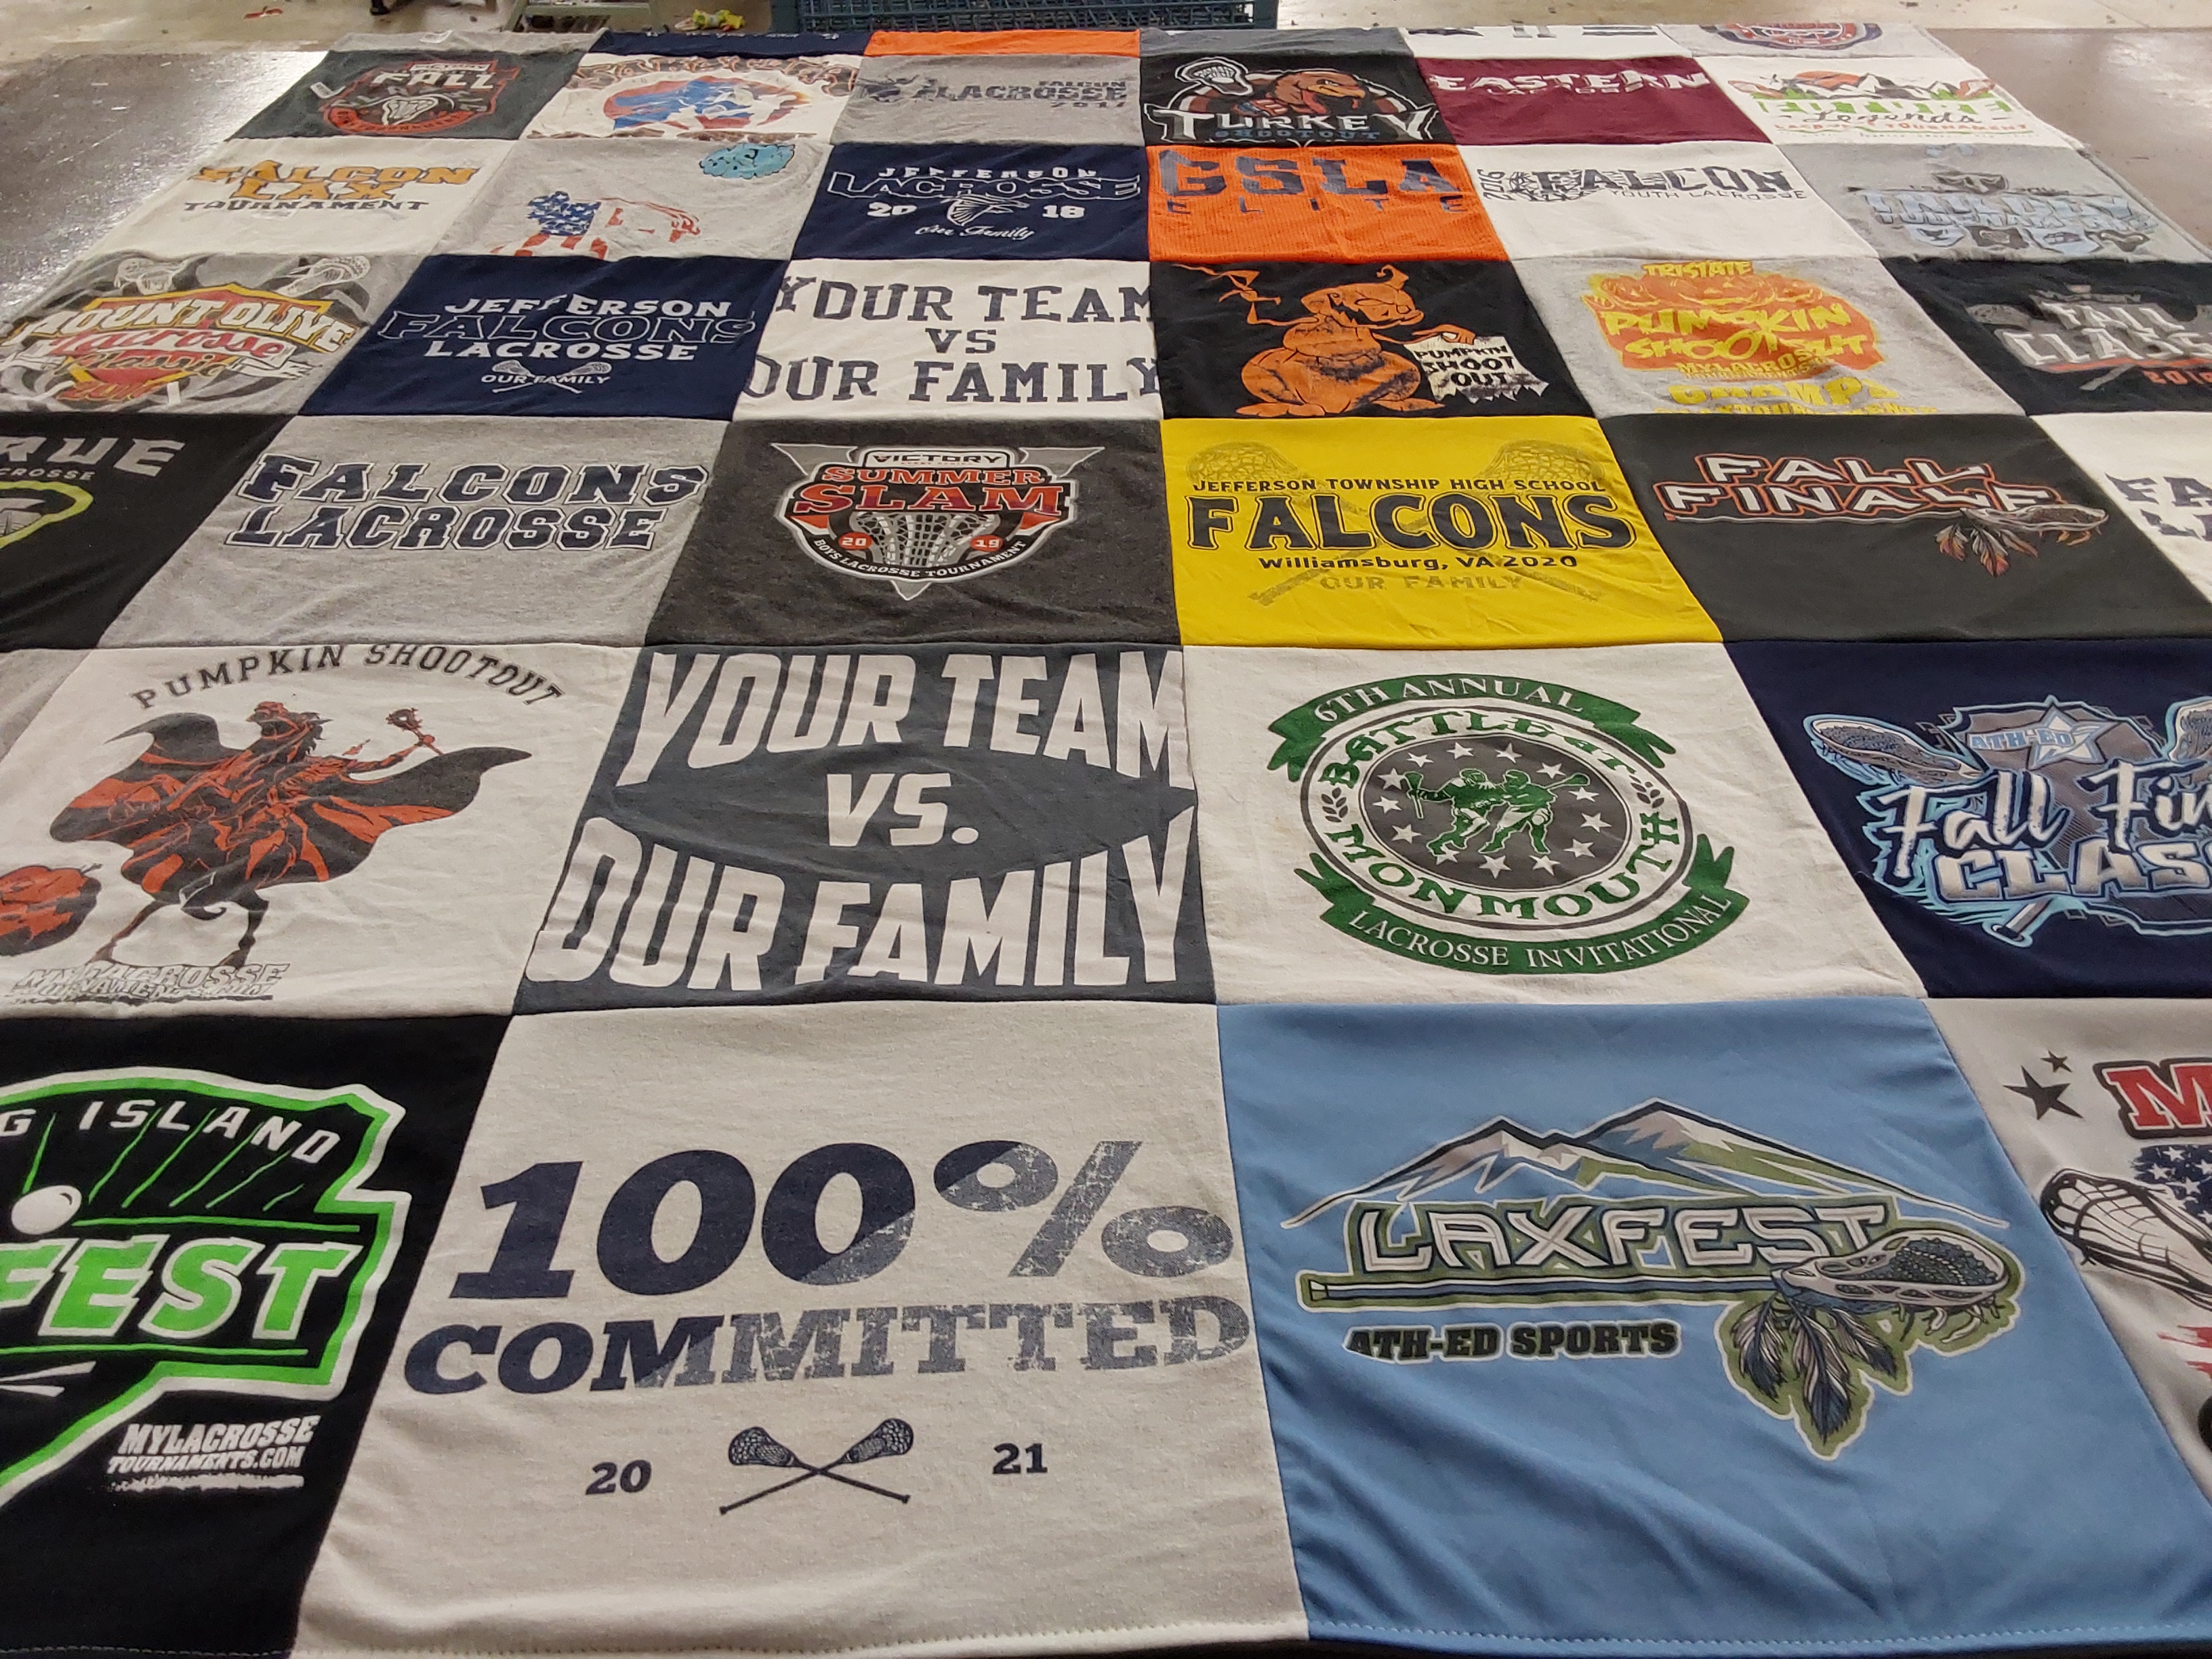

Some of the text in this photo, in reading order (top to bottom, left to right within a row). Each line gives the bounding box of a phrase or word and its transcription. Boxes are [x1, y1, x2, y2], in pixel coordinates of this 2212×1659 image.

[373, 71, 495, 89] FALL
[1430, 69, 1711, 93] EASTERN
[1147, 107, 1437, 142] TURKEY
[188, 160, 480, 185] FALCON
[229, 178, 407, 201] LAX
[1158, 149, 1462, 197] GSLA
[1530, 166, 1795, 194] FALCON
[184, 200, 430, 211] TOURNAMENT
[867, 202, 1086, 219] 20 18
[1166, 194, 1467, 215] ELITE
[1611, 190, 1680, 199] YOUTH
[444, 293, 731, 317] JEFFERSON
[777, 276, 1151, 323] YOUR TEAM
[217, 302, 356, 352] OLIVE
[378, 310, 756, 344] FALCONS
[1600, 304, 1852, 341] PUMPKIN
[424, 340, 698, 361] LACROSSE
[925, 327, 997, 354] VS
[1414, 345, 1509, 359] PUMPKIN
[481, 373, 611, 385] OUR FAMILY
[743, 354, 1160, 403] OUR FAMILY
[1423, 356, 1515, 373] SHOOT
[1451, 371, 1509, 387] OUT
[823, 466, 1046, 486] SUMMER
[872, 455, 1002, 464] VICTORY
[1695, 453, 1994, 485] FALL
[237, 453, 710, 506] FALCONS
[1193, 477, 1606, 493] JEFFERSON TOWNSHIP HIGH SCHOOL
[793, 484, 1063, 516] SLAM
[225, 505, 669, 550] LACROSSE
[1184, 491, 1638, 552] FALCONS
[815, 539, 1028, 577] BOYS LACROSSE TOURNAMENT
[842, 537, 1000, 548] 20 19
[1258, 555, 1578, 571] Williamsburg, VA 2020
[1320, 574, 1525, 591] OUR FAMILY
[131, 644, 564, 710] PUMPKIN SHOOTOUT
[1313, 678, 1586, 722] 6TH ANNUAL
[615, 650, 1195, 790] YOUR TEAM
[1969, 729, 2073, 750] ATH-ED
[827, 772, 979, 847] VS.
[1878, 770, 2060, 880] Fall
[1324, 811, 1681, 920] MONMOUTH
[1934, 837, 2212, 901] CLAS
[525, 804, 1195, 991] OUR FAMILY
[1349, 893, 1732, 970] LACROSSE INVITATIONAL
[79, 1099, 340, 1164] ISLAND
[449, 1140, 1234, 1299] 100%
[1357, 1201, 1887, 1271] LAXFEST
[405, 1294, 1251, 1396] COMMITTED
[1344, 1320, 1681, 1360] ATH-ED SPORTS
[117, 1415, 321, 1454] MYLACROSSE
[106, 1446, 306, 1474] TOURNAMENTS.COM
[585, 1442, 1049, 1495] 20 21
